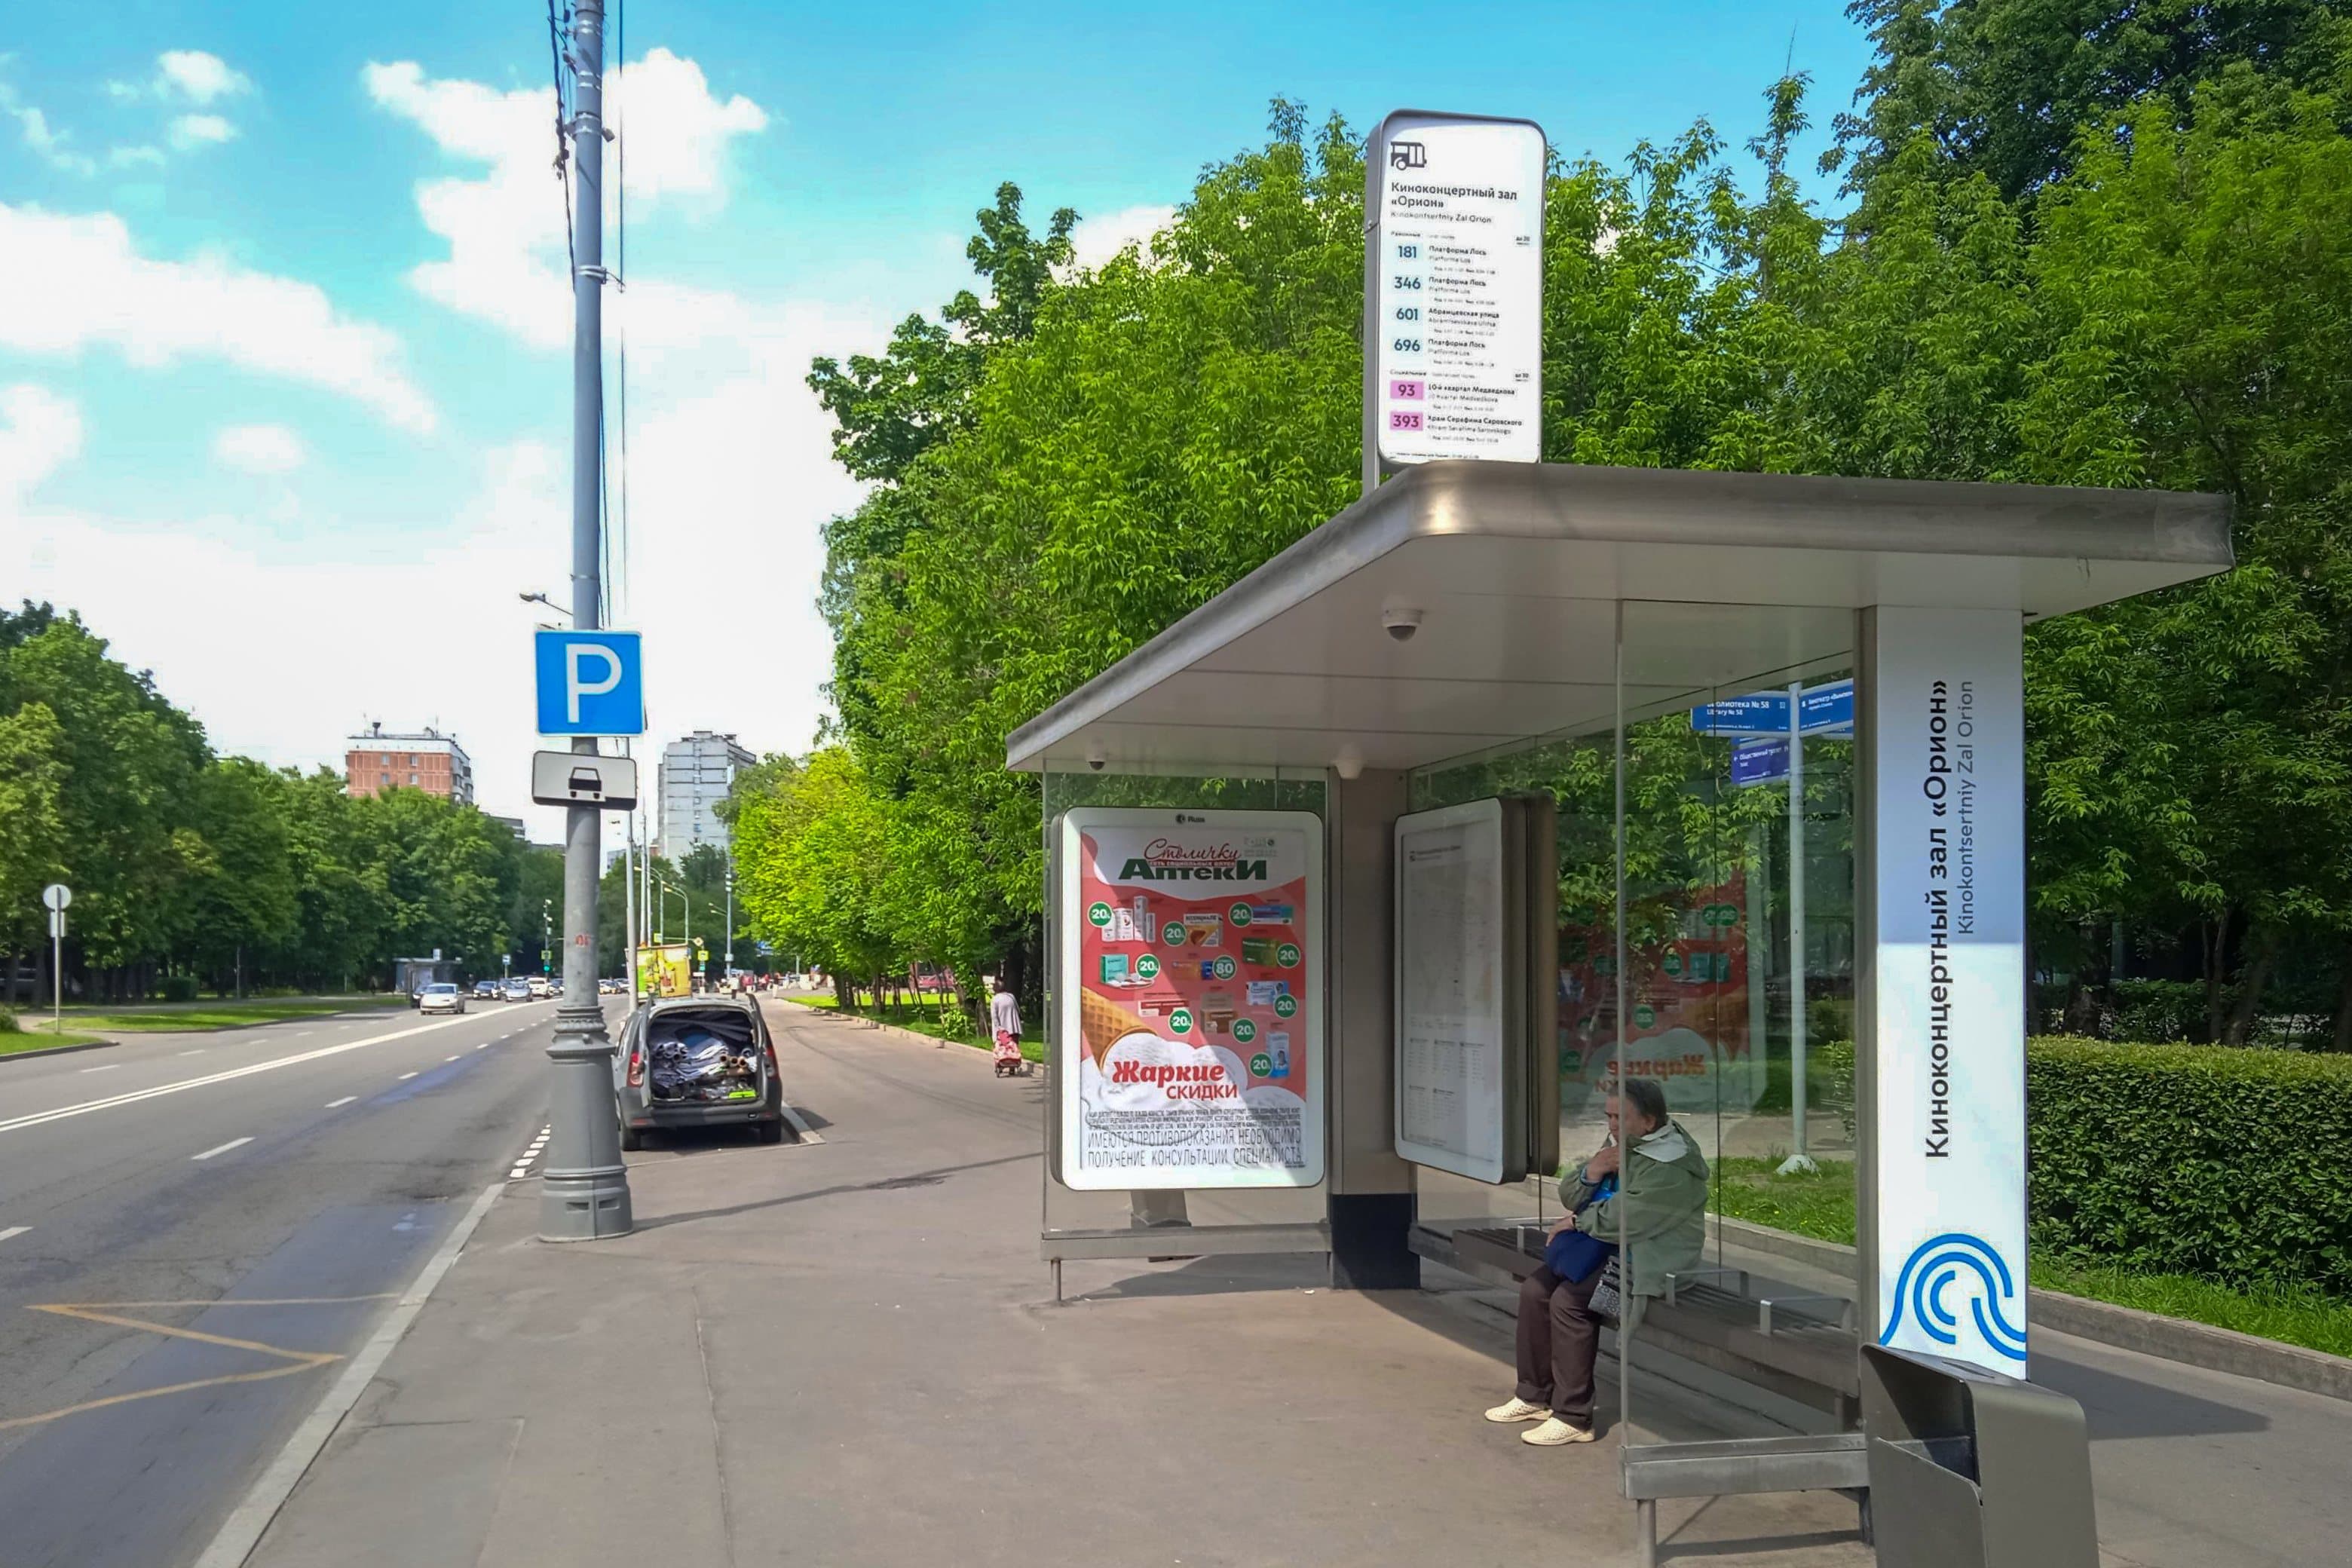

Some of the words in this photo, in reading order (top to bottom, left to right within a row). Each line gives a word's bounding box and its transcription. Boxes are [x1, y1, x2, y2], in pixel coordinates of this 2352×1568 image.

[1391, 182, 1495, 198] Киноконцертный
[1497, 190, 1517, 200] зал
[1391, 195, 1444, 208] «Орион»
[1469, 215, 1492, 223] Orion
[1398, 245, 1416, 258] 181
[1429, 246, 1468, 254] Платформа
[1395, 277, 1421, 289] 346
[1429, 277, 1468, 285] Платформа
[1396, 308, 1418, 321] 601
[1429, 308, 1478, 317] Абрамцевская
[1395, 338, 1420, 352] 696
[1429, 338, 1468, 348] Платформа
[1398, 384, 1416, 397] 93
[1393, 415, 1419, 427] 393
[1447, 415, 1482, 424] Серафима
[1483, 418, 1522, 426] Саровского
[566, 643, 623, 724] P
[1760, 700, 1769, 709] 58
[1957, 681, 1974, 738] Orion
[1923, 680, 1952, 817] «Орион»
[1957, 744, 1974, 773] Zal
[1144, 838, 1242, 860] Столички
[1929, 828, 1947, 880] зал
[1958, 778, 1977, 934] Kinokontsertniy
[1216, 963, 1233, 974] 80
[1924, 890, 1953, 1157] Киноконцертный
[1112, 1060, 1225, 1088] Жаркие
[1088, 1131, 1134, 1148] ИМЕЮТСЯ
[1239, 1128, 1301, 1145] НЕОБХОДИМО
[1088, 1150, 1146, 1167] ПОЛУЧЕНИЕ
[1152, 1149, 1228, 1166] КОНСУЛЬТАЦИИ
[1233, 1147, 1301, 1165] СПЕЦИАЛИСТА
